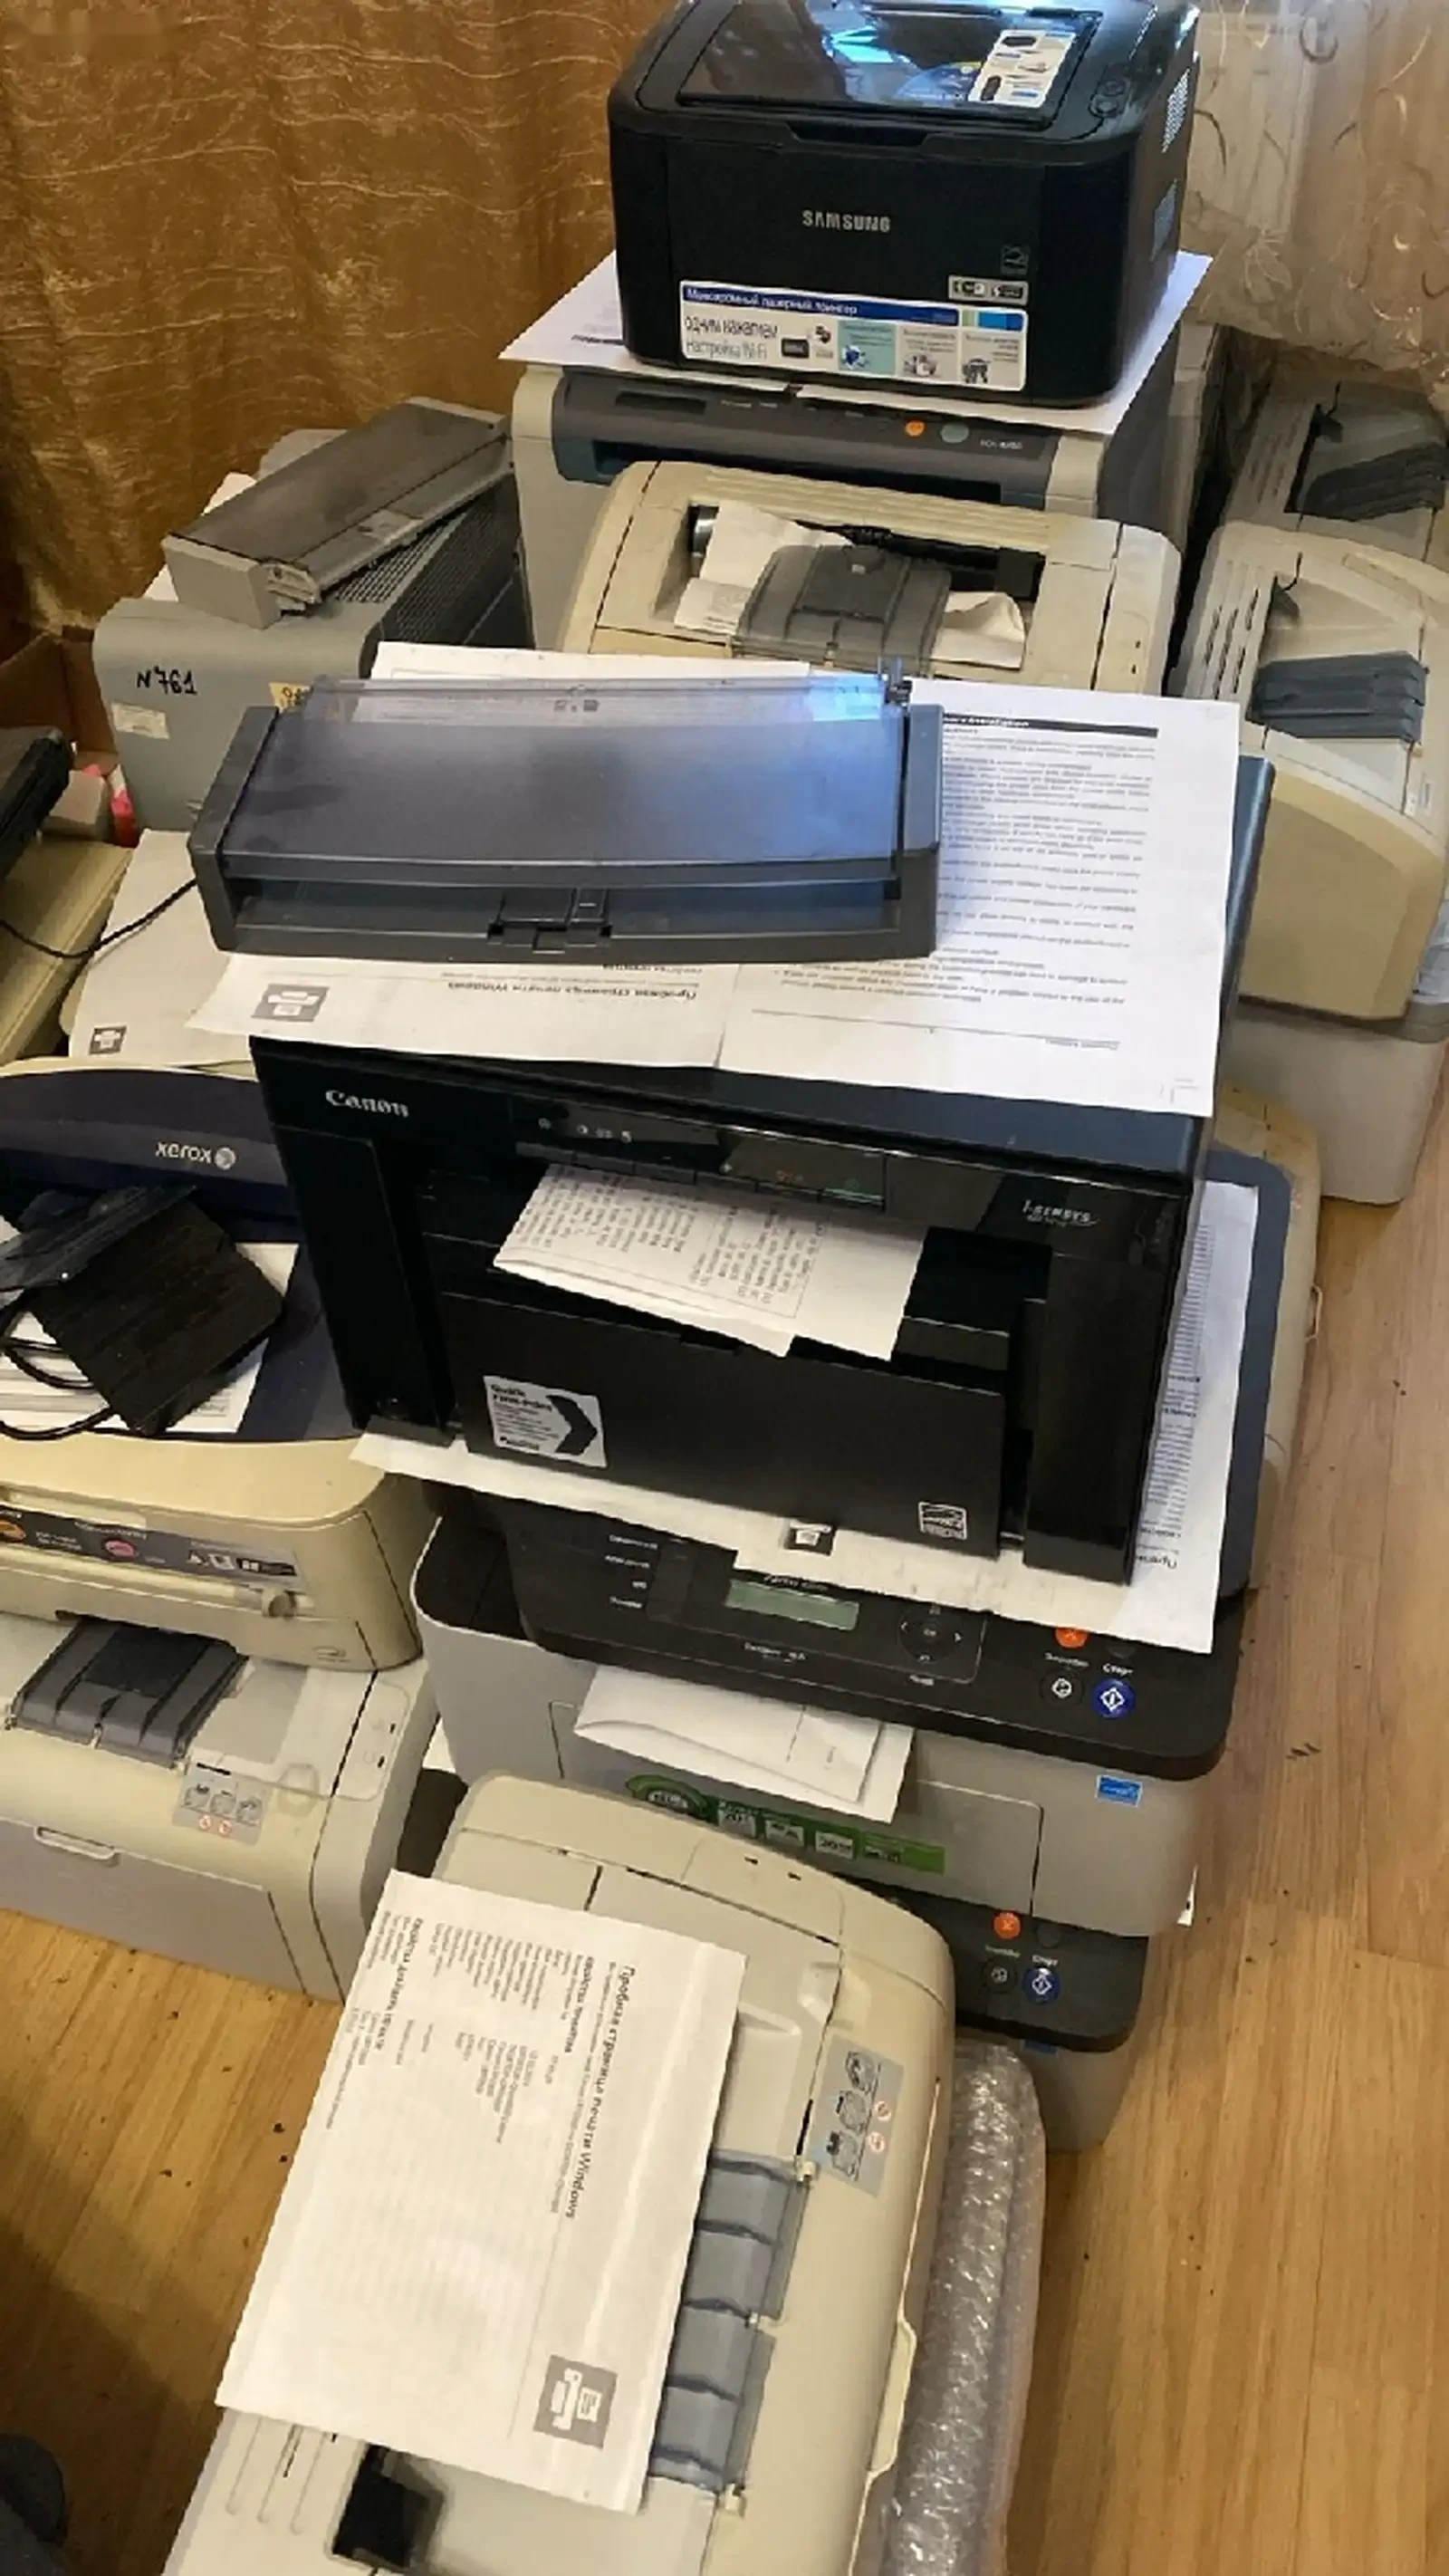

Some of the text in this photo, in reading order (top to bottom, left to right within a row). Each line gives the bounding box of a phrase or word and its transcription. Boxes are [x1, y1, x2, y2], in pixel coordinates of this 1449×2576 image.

[802, 209, 890, 232] SAMSUNG
[325, 1089, 409, 1119] Canon
[155, 1141, 212, 1164] xerox
[564, 1965, 635, 2220] Пробная страница печати Windows
